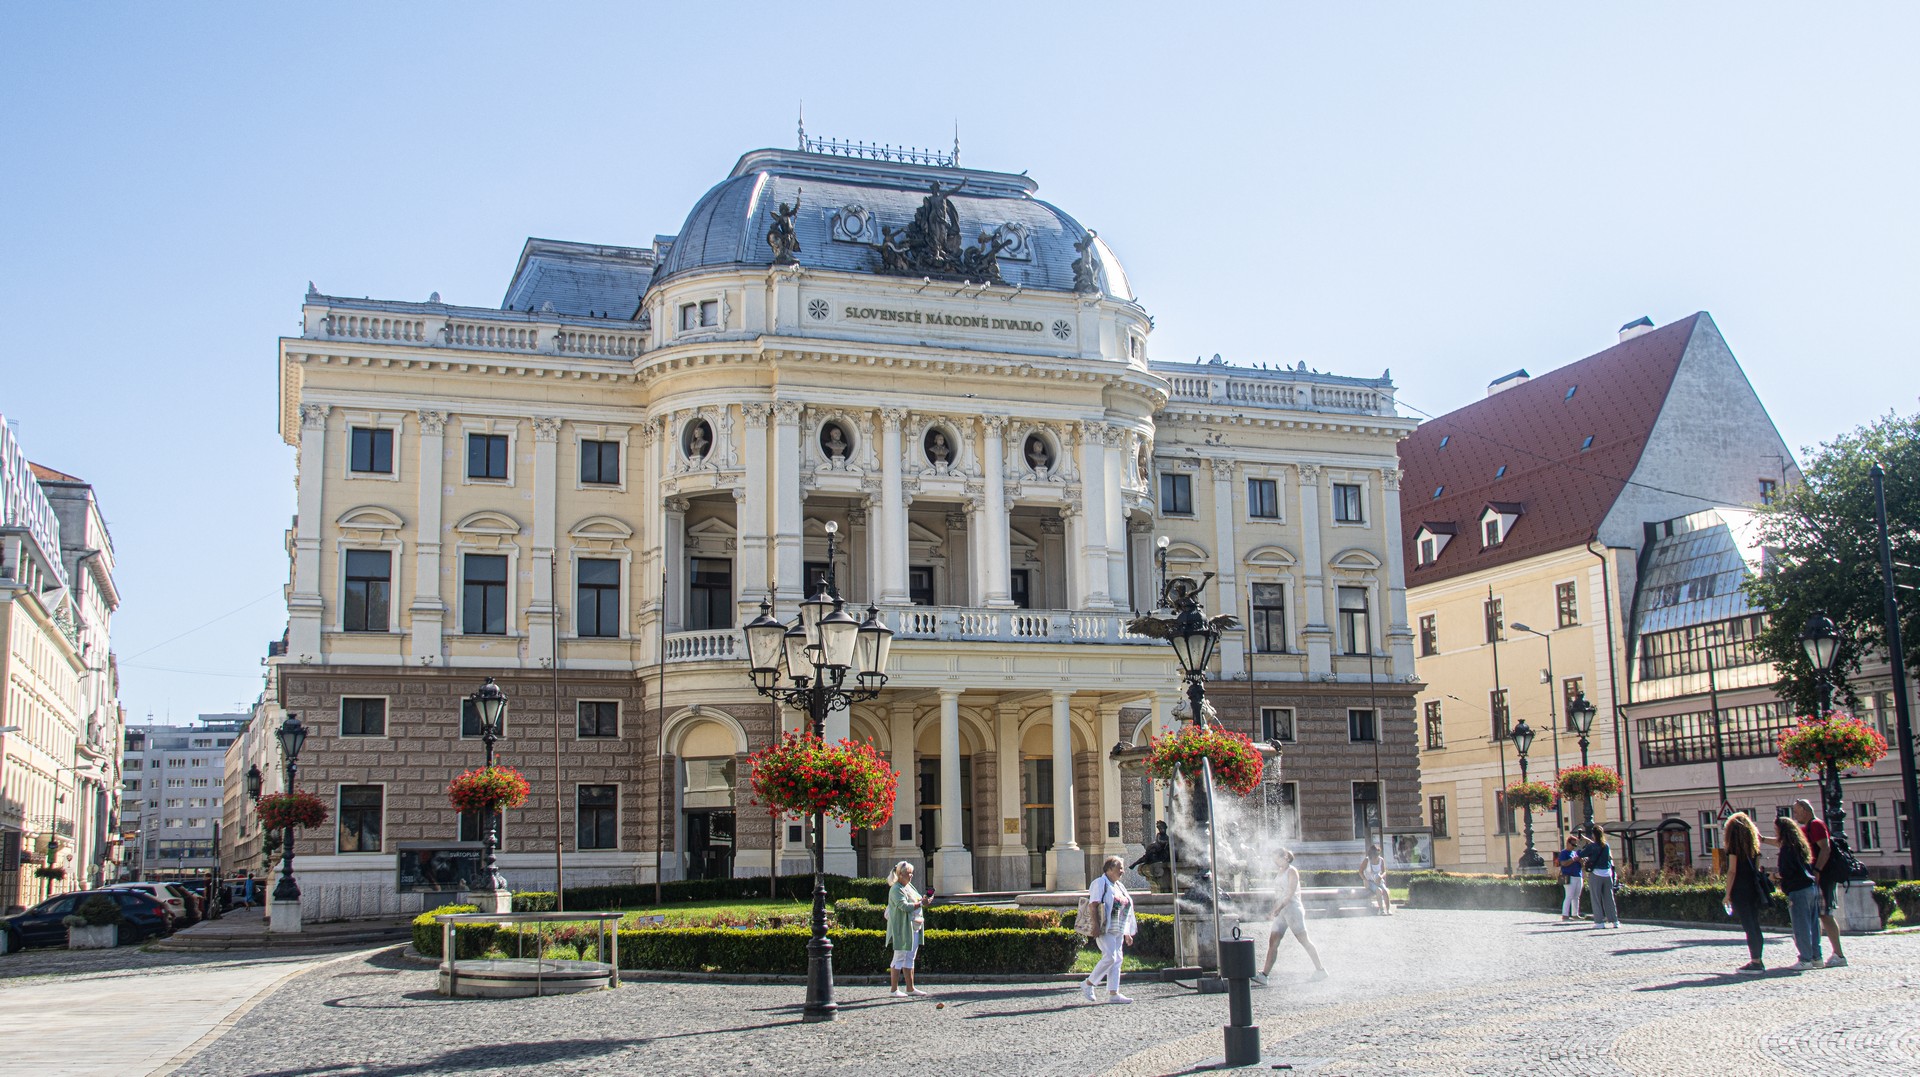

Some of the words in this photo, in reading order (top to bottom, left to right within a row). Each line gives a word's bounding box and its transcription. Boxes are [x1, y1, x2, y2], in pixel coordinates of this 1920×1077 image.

[845, 307, 921, 324] SLOVENSKÉ
[926, 312, 988, 329] NÁRODNÉ
[991, 319, 1044, 332] DIVADLO
